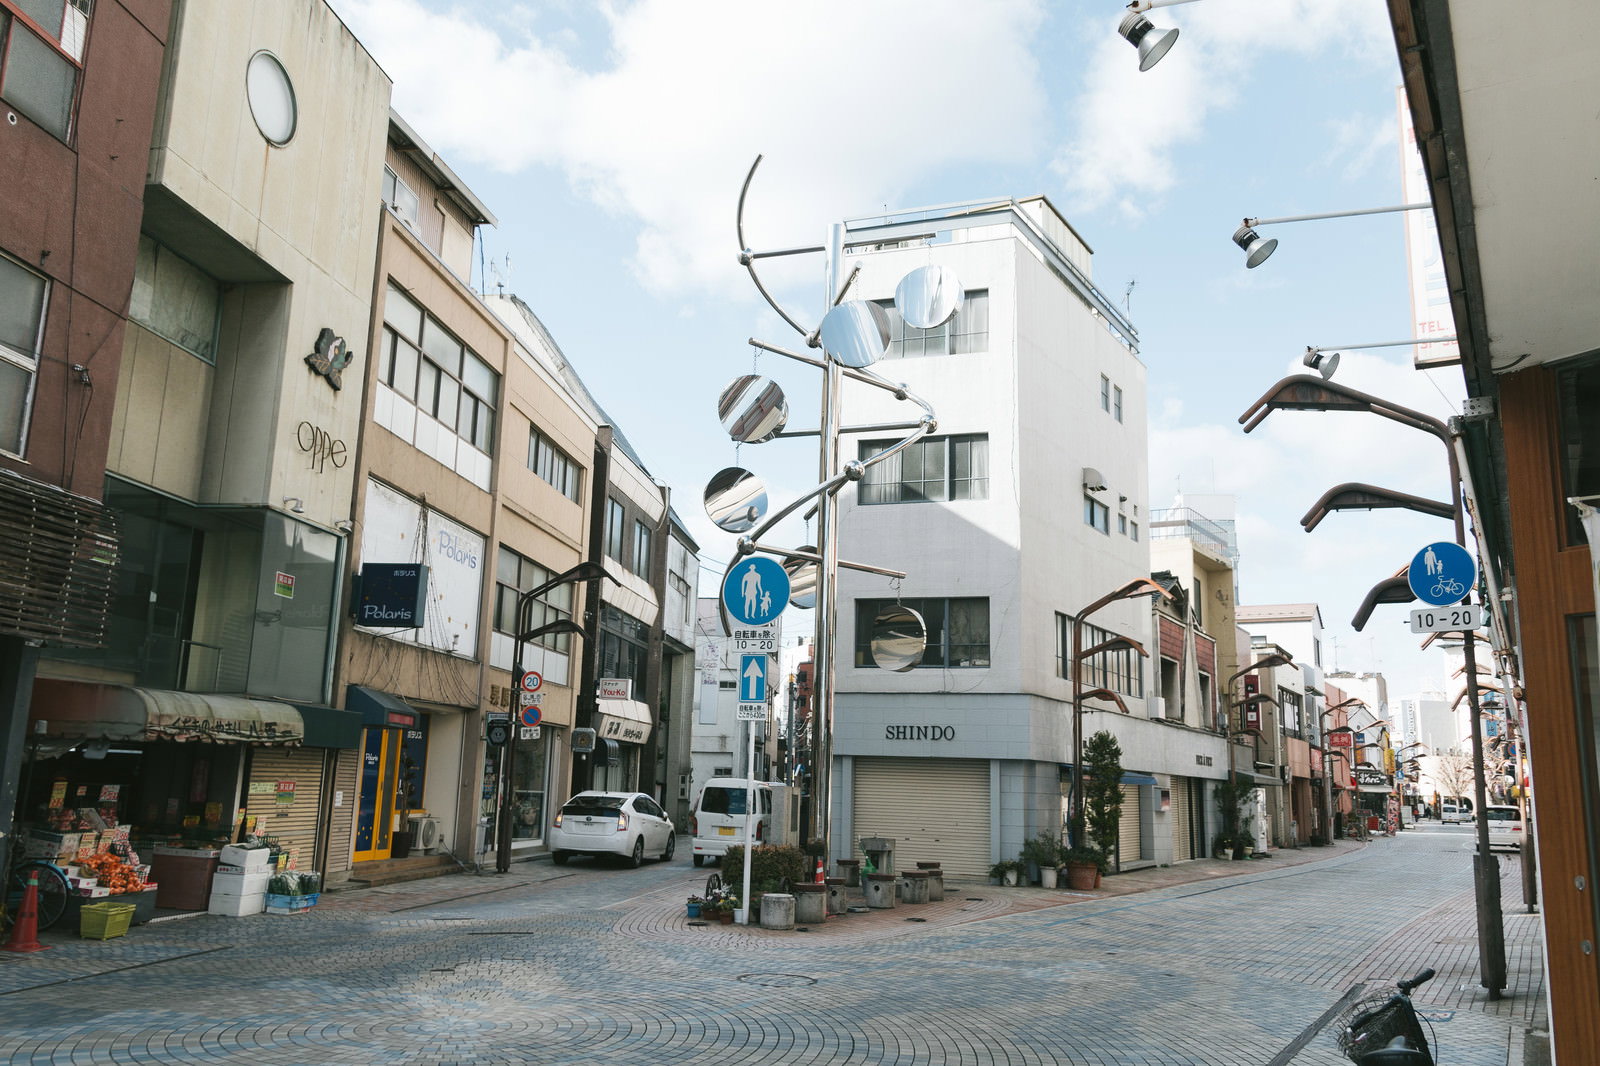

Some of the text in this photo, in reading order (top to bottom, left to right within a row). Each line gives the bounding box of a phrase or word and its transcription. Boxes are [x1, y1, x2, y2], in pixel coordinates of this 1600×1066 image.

[1419, 320, 1450, 334] TEL.
[439, 530, 477, 569] Polaris
[393, 569, 417, 577] ポラリス
[364, 604, 412, 620] Polaris
[734, 630, 776, 639] 自転車を除く
[526, 676, 539, 687] 20
[885, 725, 955, 741] SHINDO
